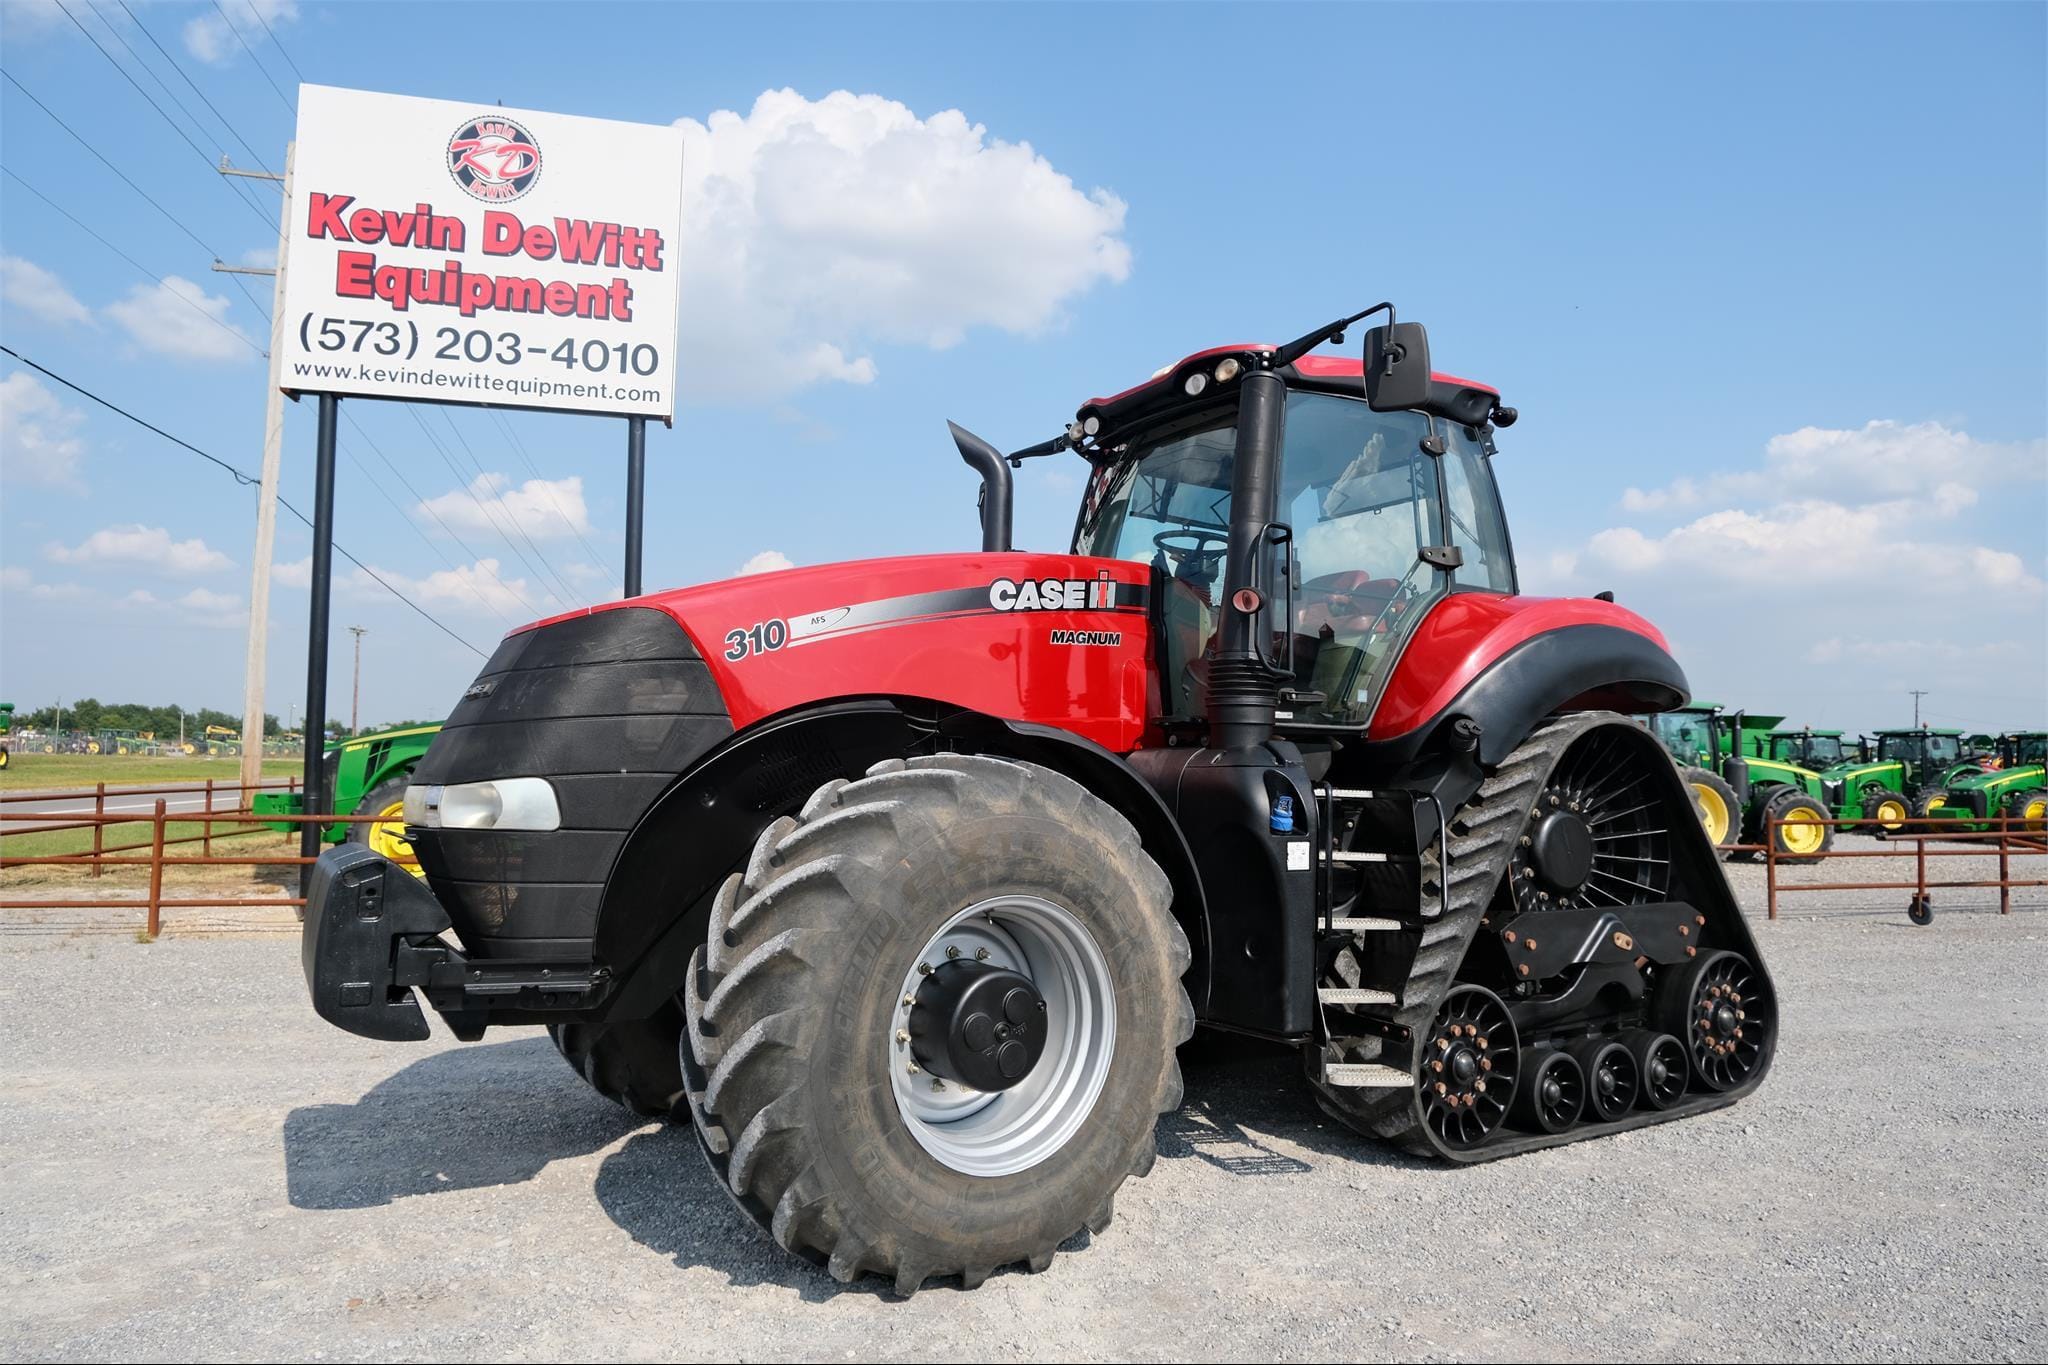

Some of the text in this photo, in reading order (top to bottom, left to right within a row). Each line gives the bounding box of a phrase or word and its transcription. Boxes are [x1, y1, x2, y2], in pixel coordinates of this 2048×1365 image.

[475, 122, 516, 140] Kevin
[470, 180, 518, 198] DeWitt
[307, 192, 664, 272] Kevin DeWitt
[336, 250, 634, 322] Equipment
[299, 312, 660, 377] (573) 203-4010
[293, 363, 661, 403] www.kevindewittequipment.com
[989, 579, 1086, 611] CASE
[810, 616, 826, 625] AFS
[1050, 629, 1121, 646] MAGNUM
[725, 618, 787, 662] 310
